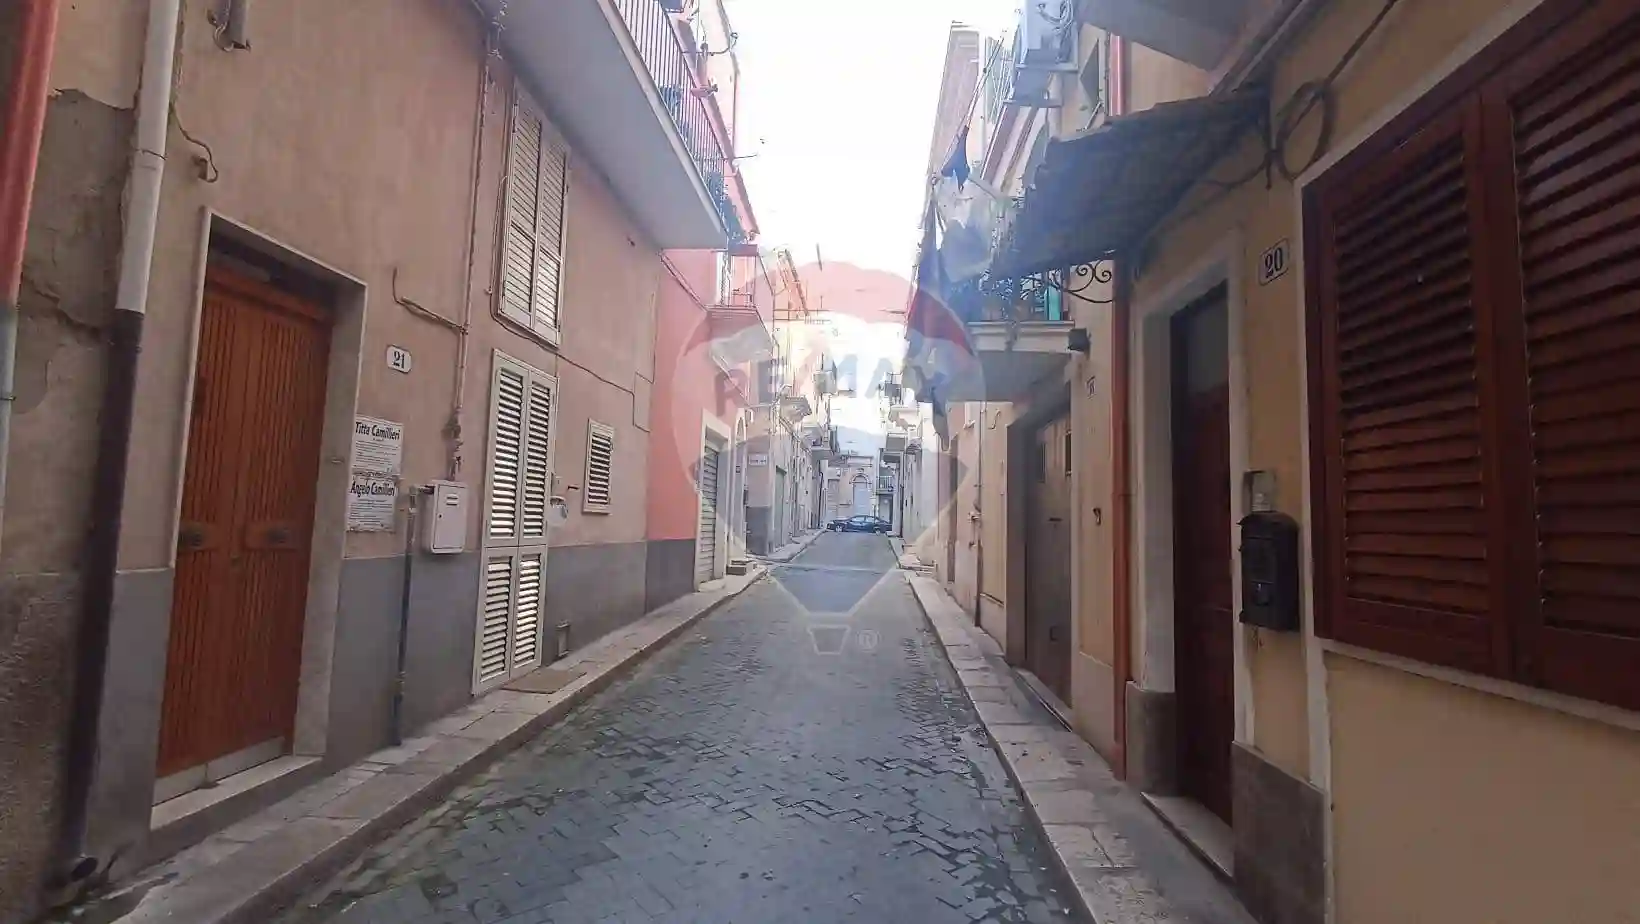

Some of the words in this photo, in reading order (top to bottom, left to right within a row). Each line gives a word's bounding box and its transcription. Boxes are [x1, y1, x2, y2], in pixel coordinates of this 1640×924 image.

[1264, 247, 1283, 279] 20
[393, 350, 405, 369] 21
[355, 421, 371, 436] Titta
[350, 479, 370, 498] Angelo
